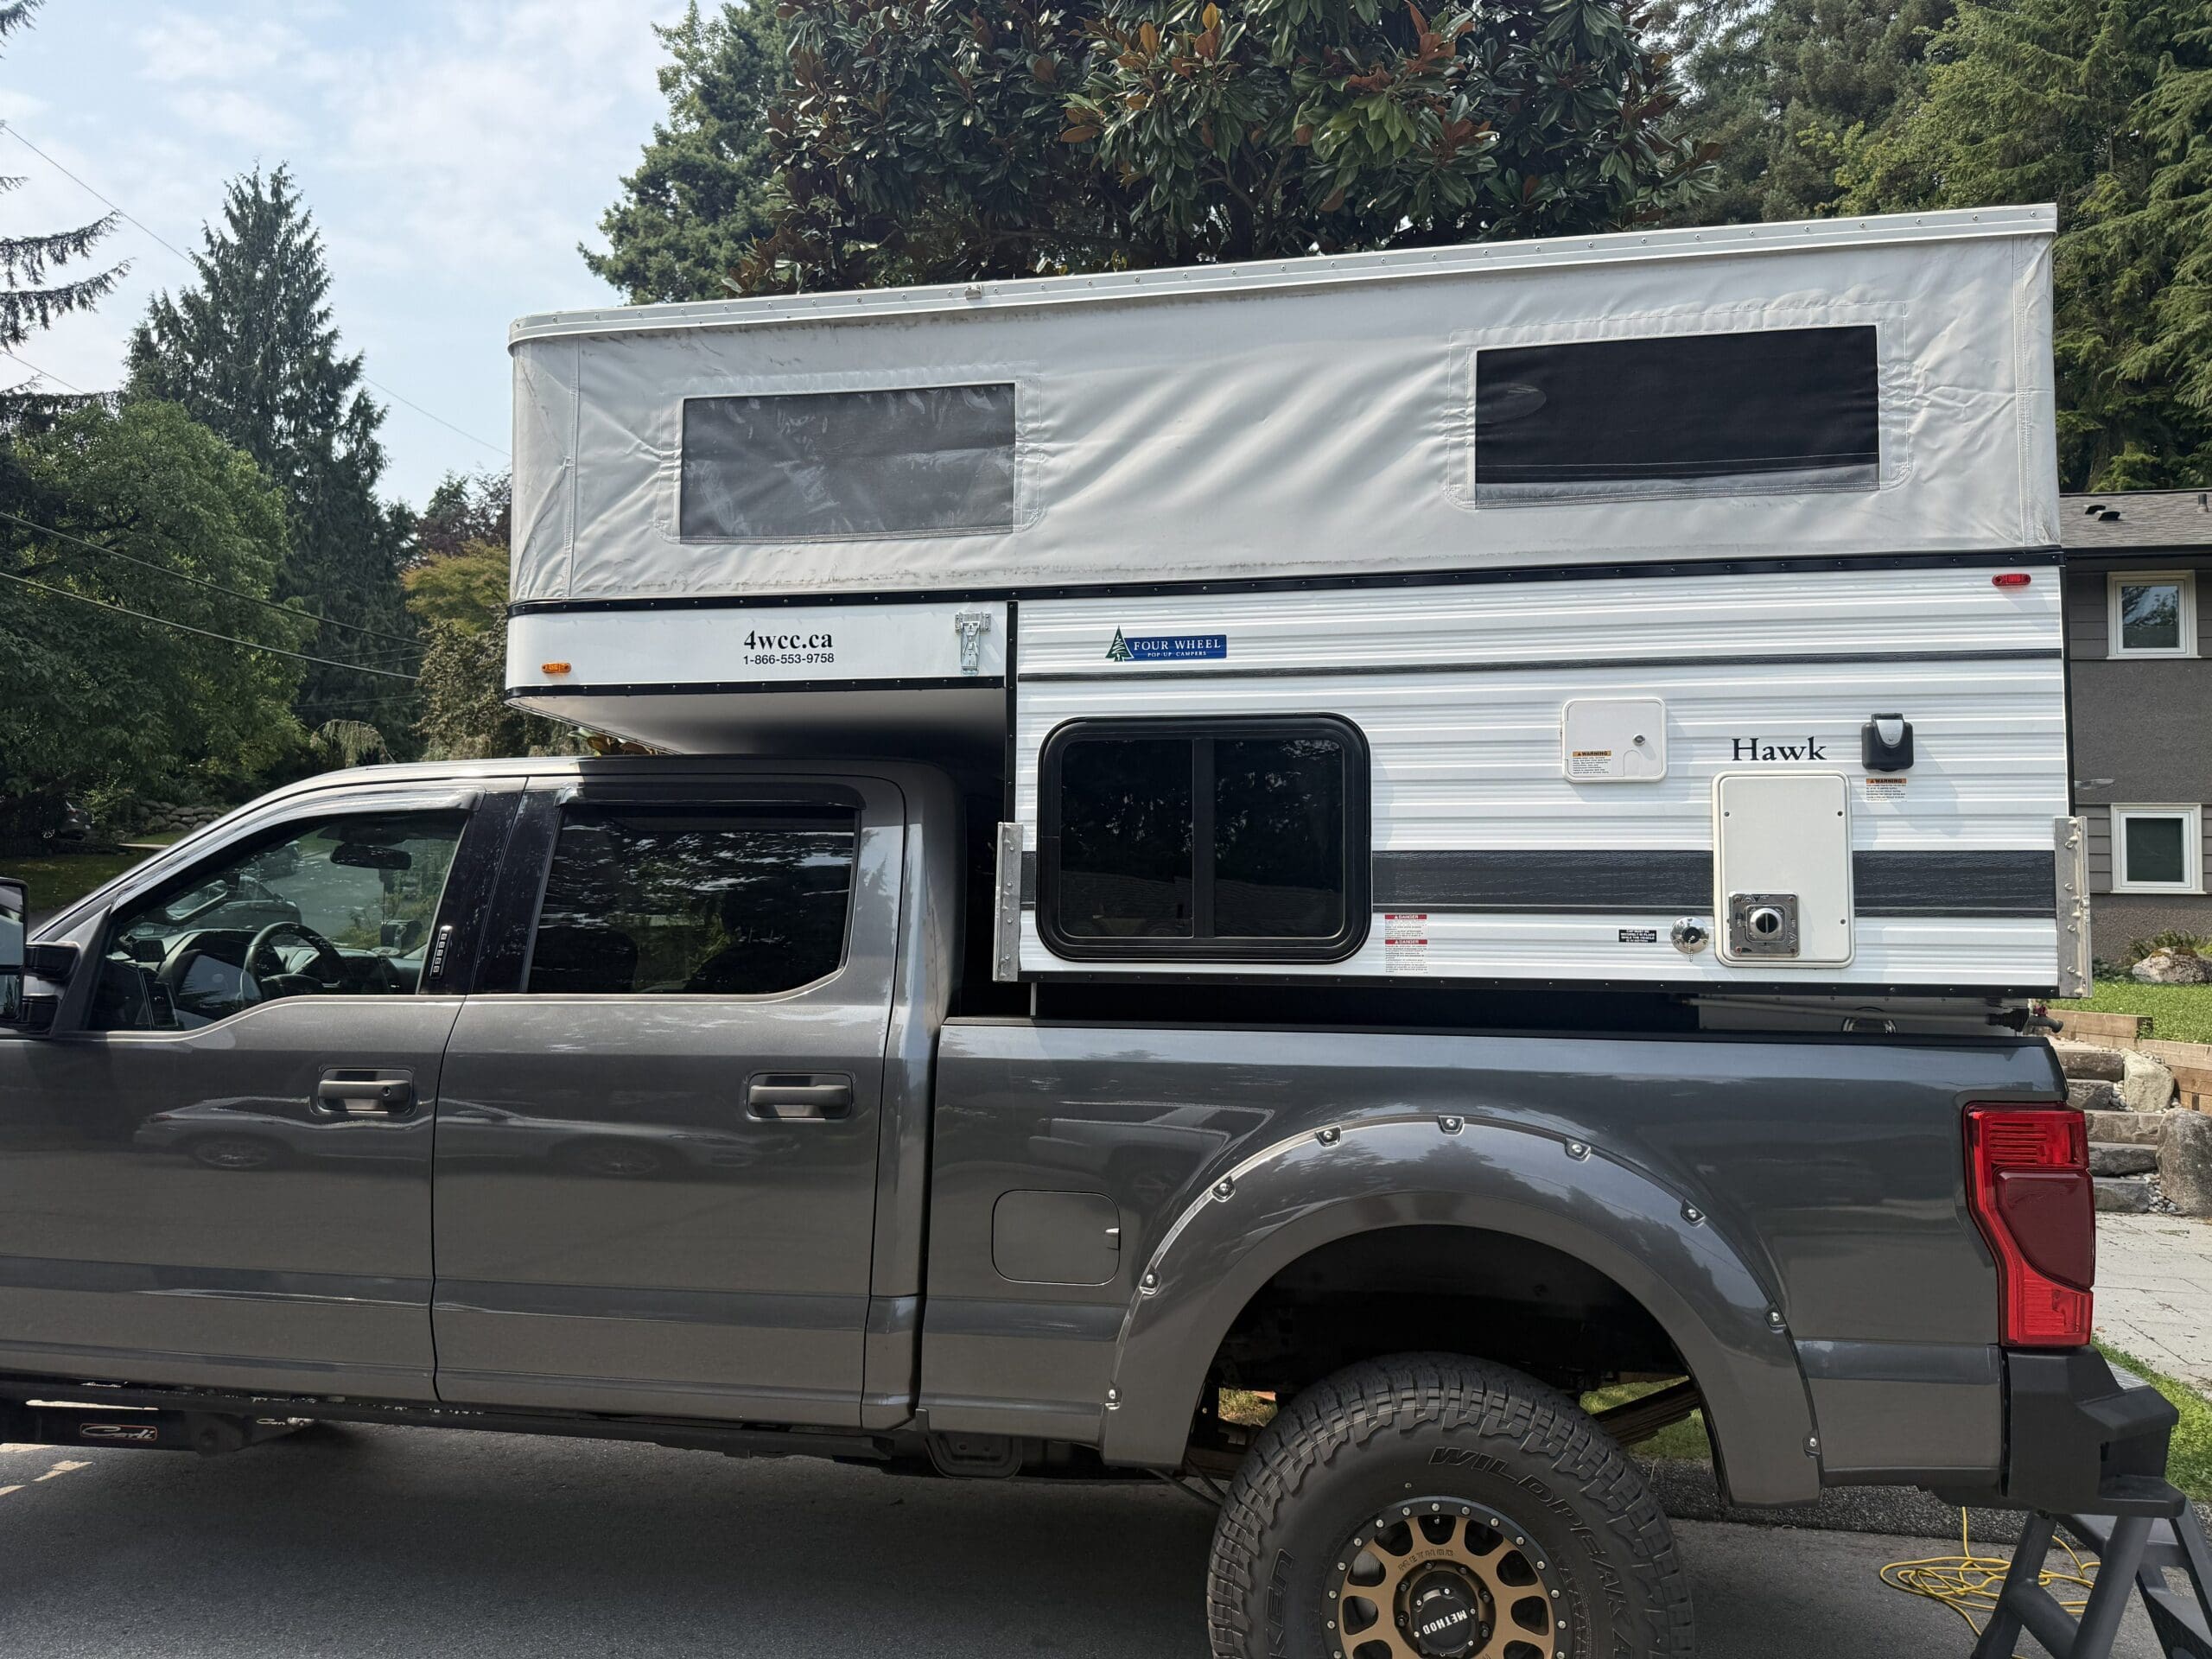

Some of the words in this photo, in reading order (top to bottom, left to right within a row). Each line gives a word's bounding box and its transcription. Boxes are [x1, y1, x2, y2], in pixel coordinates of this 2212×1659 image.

[744, 630, 833, 650] 4wcc.ca
[1134, 640, 1168, 651] FOUR
[1174, 639, 1221, 650] WHEEL
[743, 653, 835, 664] 1-866-553-9758
[1732, 735, 1827, 760] Hawk
[1422, 1610, 1468, 1635] METHOD
